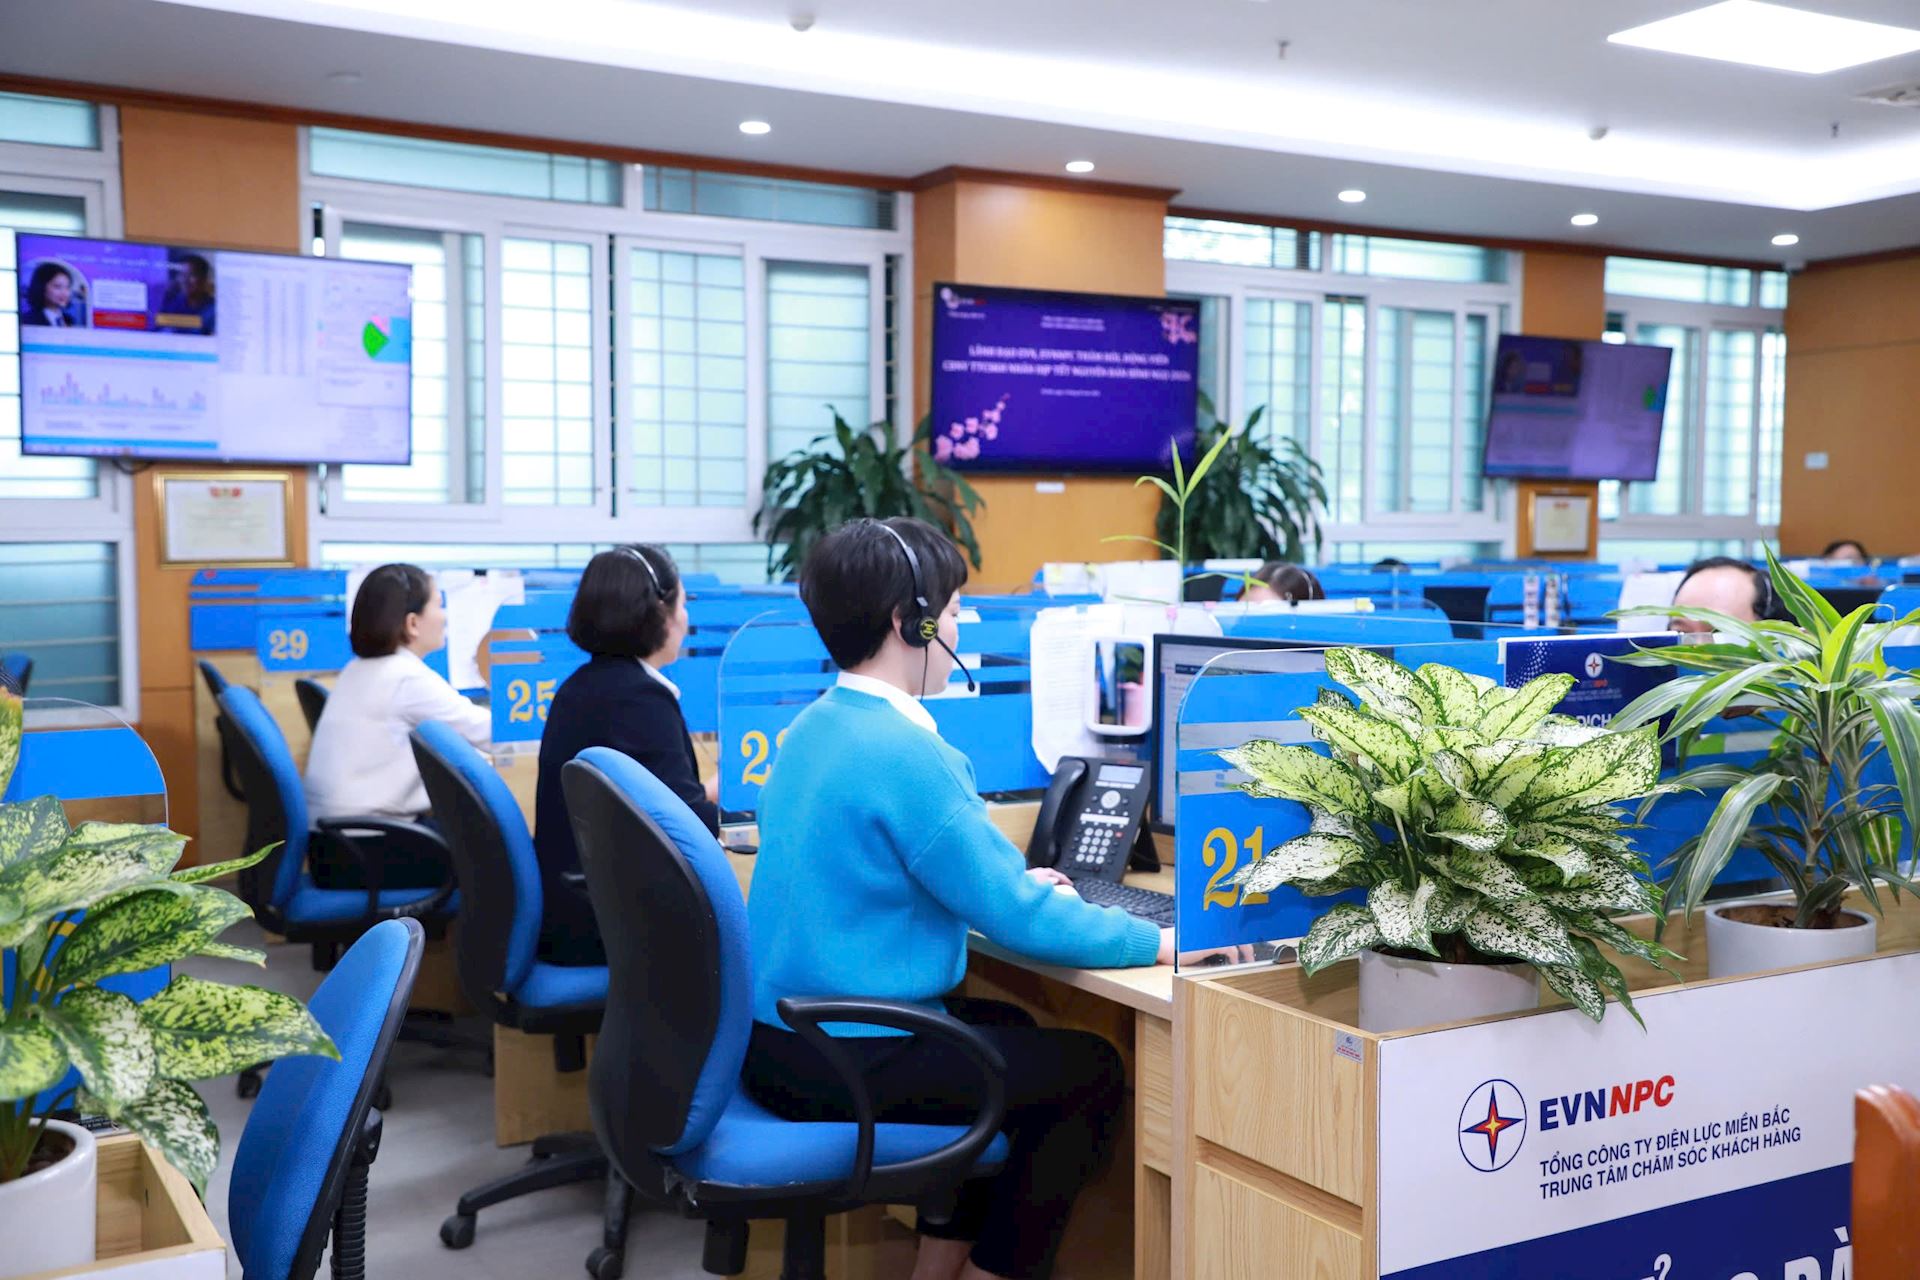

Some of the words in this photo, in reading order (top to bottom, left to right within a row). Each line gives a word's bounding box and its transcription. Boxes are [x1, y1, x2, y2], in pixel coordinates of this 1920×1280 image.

[269, 629, 309, 660] 29
[741, 729, 788, 786] 2
[1202, 825, 1270, 911] 21
[1540, 1075, 1675, 1132] EVNNPC
[1540, 1150, 1583, 1177] TỔNG
[1587, 1144, 1630, 1166] CÔNG
[1634, 1137, 1653, 1155] TY
[1656, 1128, 1690, 1151] ĐIỆN
[1694, 1122, 1721, 1144] LỰC
[1725, 1111, 1759, 1136] MIỀN
[1762, 1104, 1790, 1128] BẮC
[1540, 1174, 1593, 1199] TRUNG
[1597, 1164, 1628, 1186] TÂM
[1632, 1154, 1673, 1178] CHĂM
[1678, 1146, 1707, 1168] SÓC
[1712, 1136, 1759, 1160] KHÁCH
[1763, 1127, 1801, 1149] HÀNG
